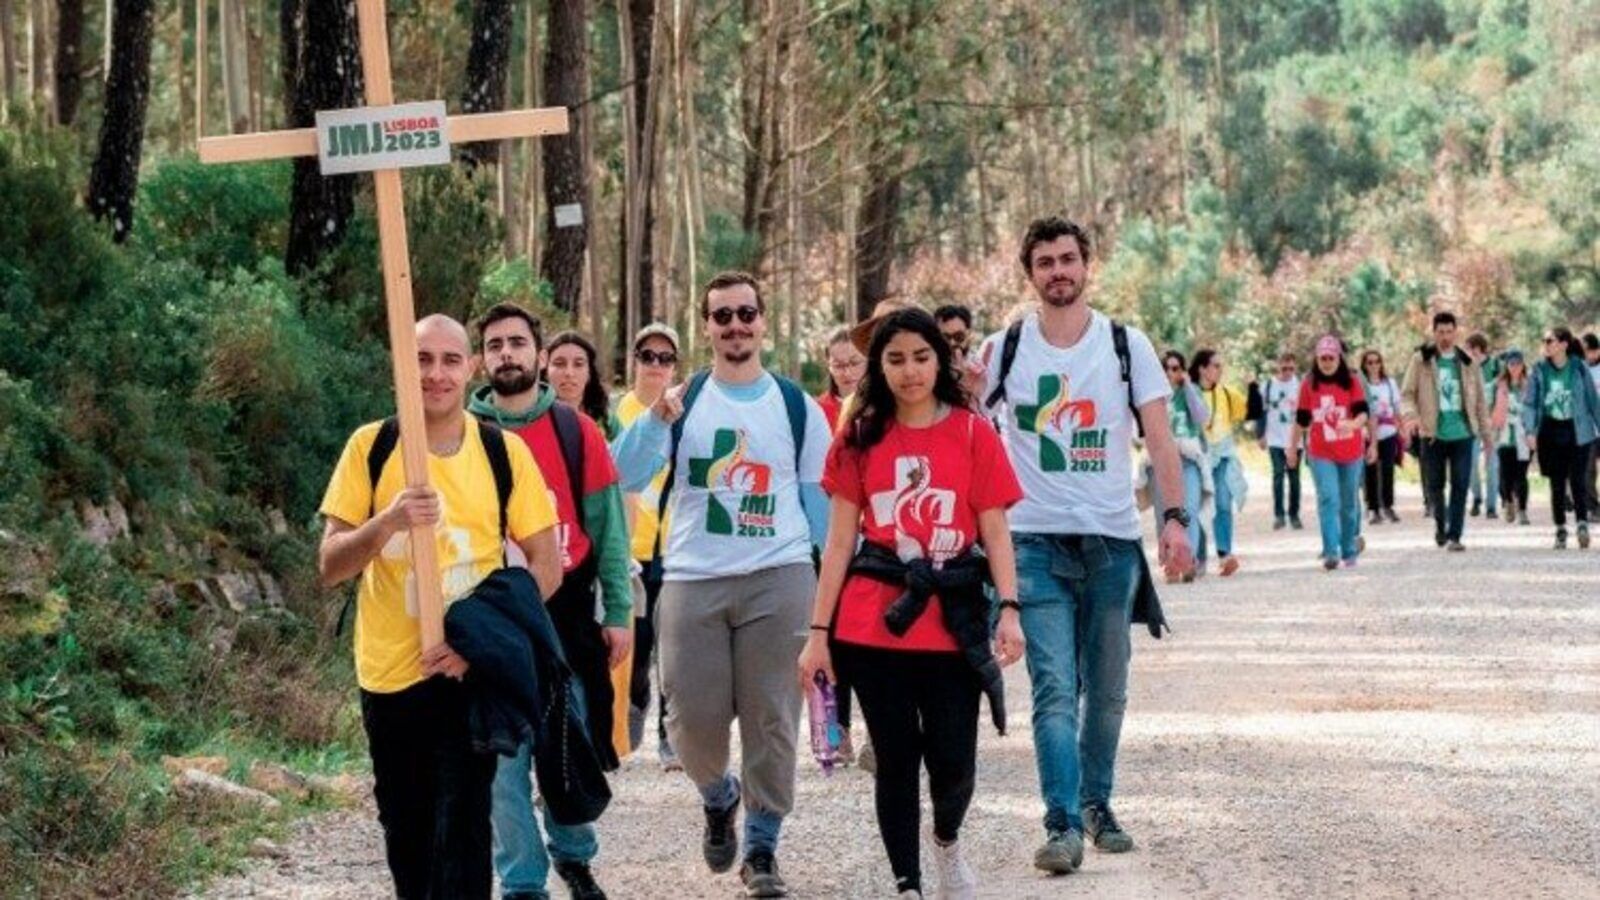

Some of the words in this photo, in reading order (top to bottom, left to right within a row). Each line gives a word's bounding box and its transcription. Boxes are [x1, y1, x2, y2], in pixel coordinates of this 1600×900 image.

[384, 117, 439, 133] LISBOA
[328, 121, 383, 157] JMJ
[385, 131, 441, 152] 2023
[1071, 429, 1107, 449] JMJ
[738, 494, 775, 516] JMJ
